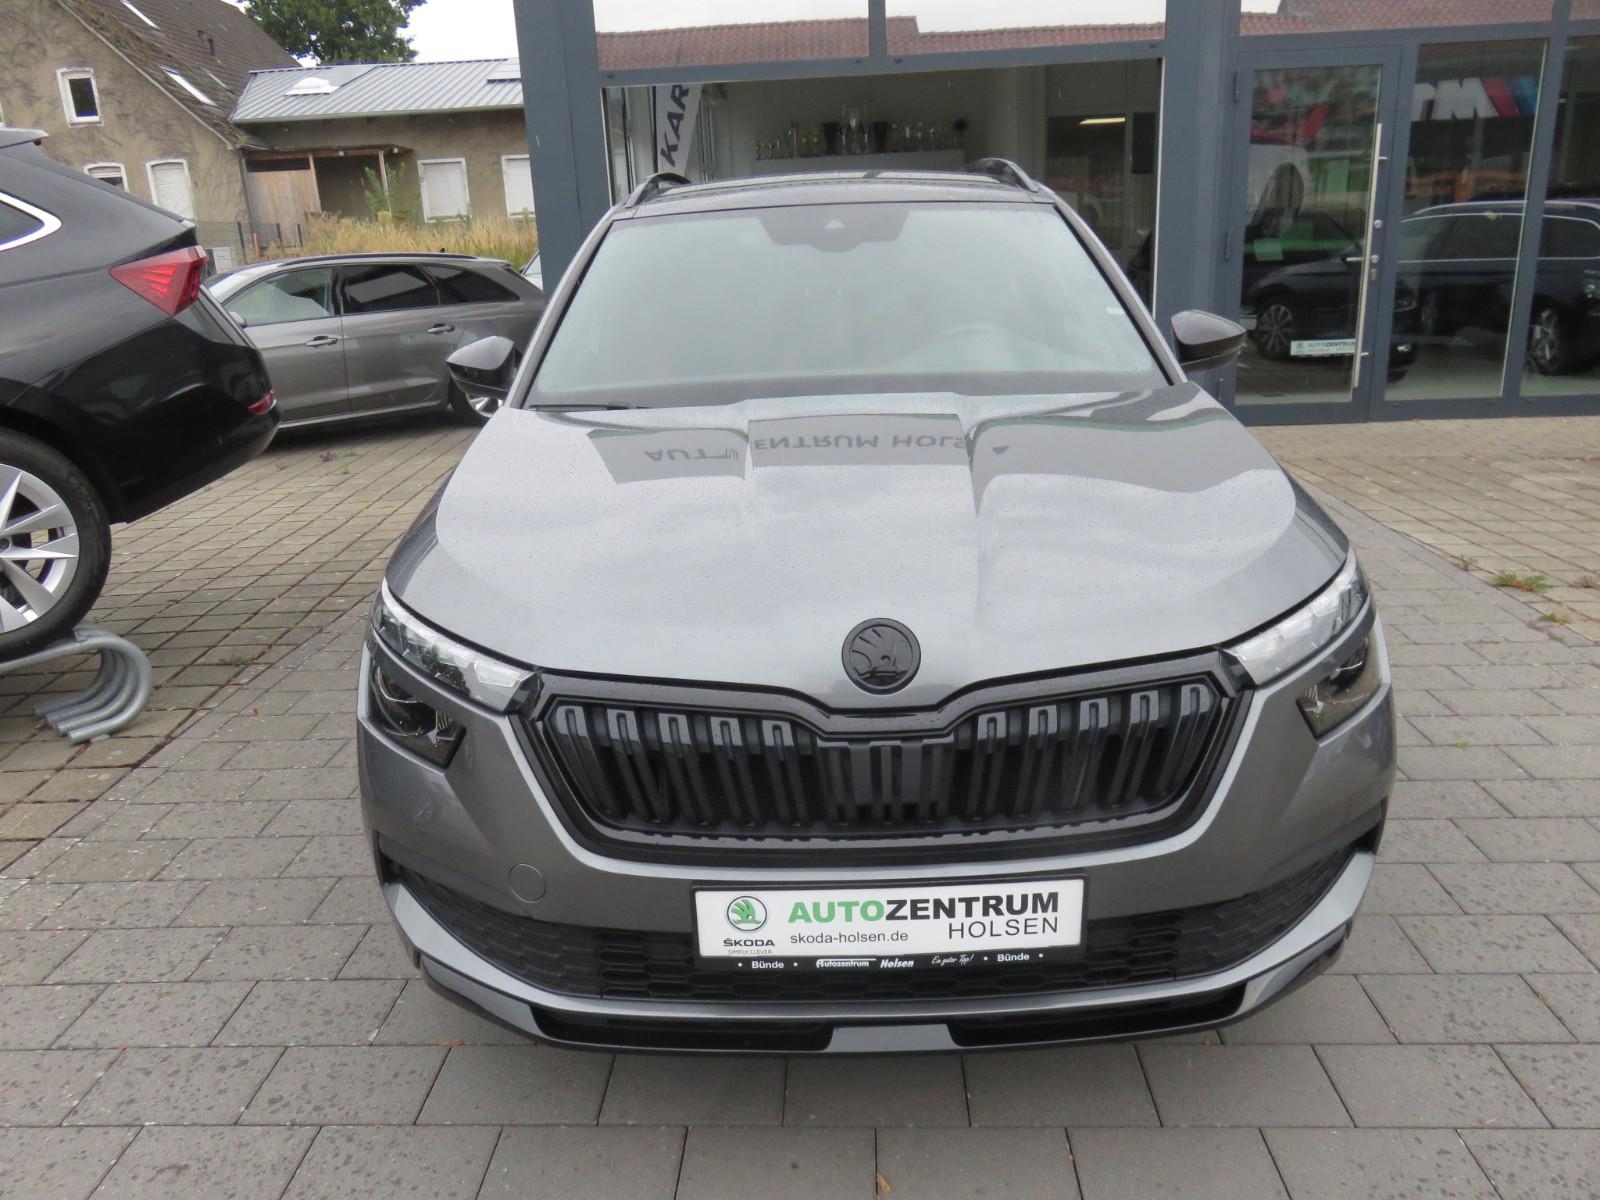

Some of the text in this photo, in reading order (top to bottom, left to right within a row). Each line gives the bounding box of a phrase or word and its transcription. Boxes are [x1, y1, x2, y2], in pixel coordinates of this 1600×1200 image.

[787, 892, 1059, 924] AUTOZENTRUM
[949, 916, 1058, 939] HOLSEN
[723, 937, 776, 947] ŠKODA
[790, 930, 909, 944] skoda-holsen.de
[751, 960, 785, 970] Bünde
[880, 959, 914, 969] Holsen
[997, 953, 1030, 962] Bünde
